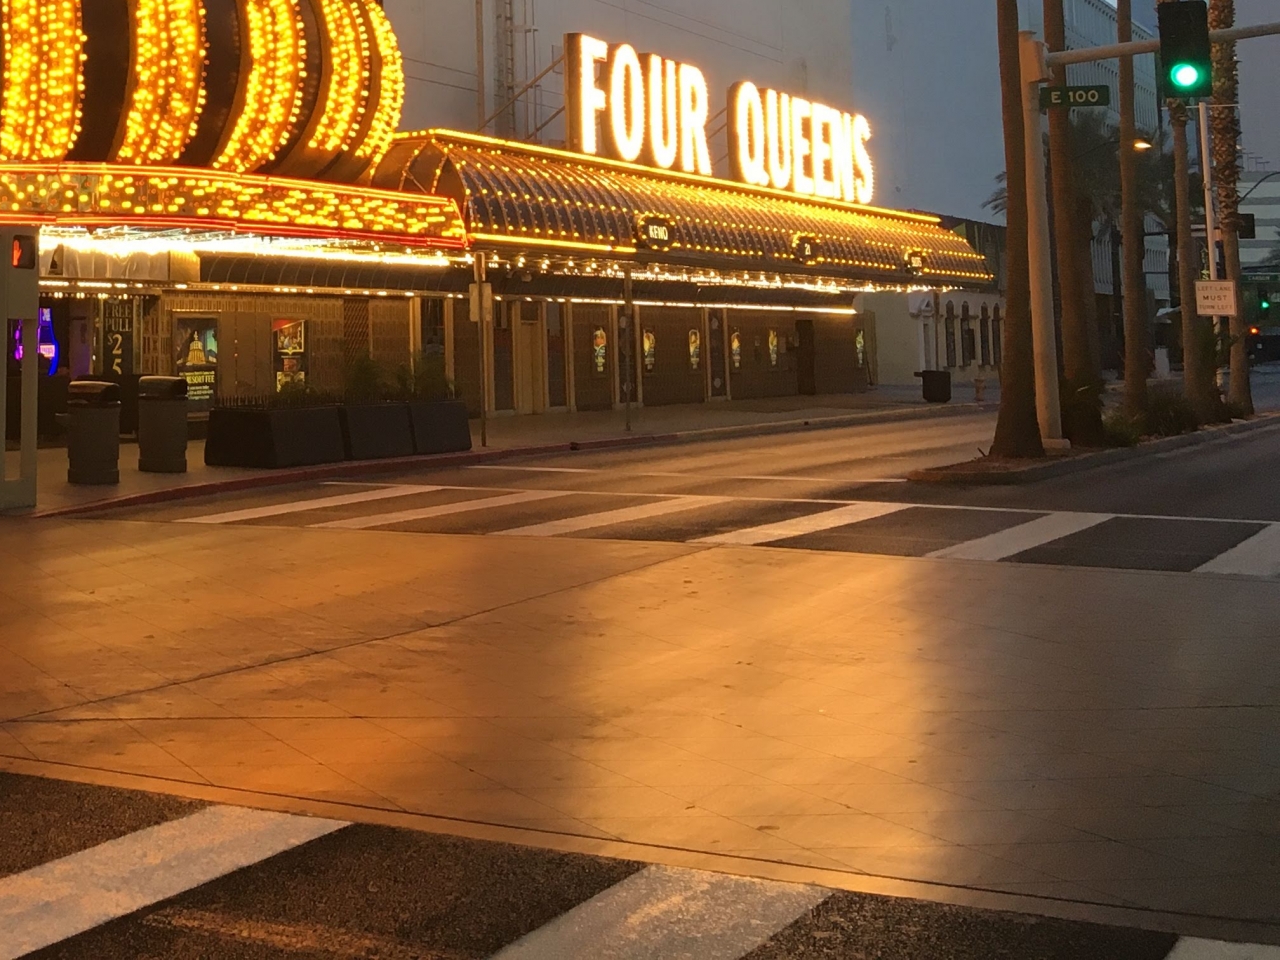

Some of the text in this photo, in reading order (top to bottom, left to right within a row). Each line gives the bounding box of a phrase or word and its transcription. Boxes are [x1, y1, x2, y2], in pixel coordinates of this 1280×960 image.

[1051, 90, 1099, 103] E 100
[577, 33, 874, 204] FOUR QUEENS
[648, 224, 668, 241] KENO
[105, 303, 131, 318] FREE
[105, 318, 132, 332] PULL
